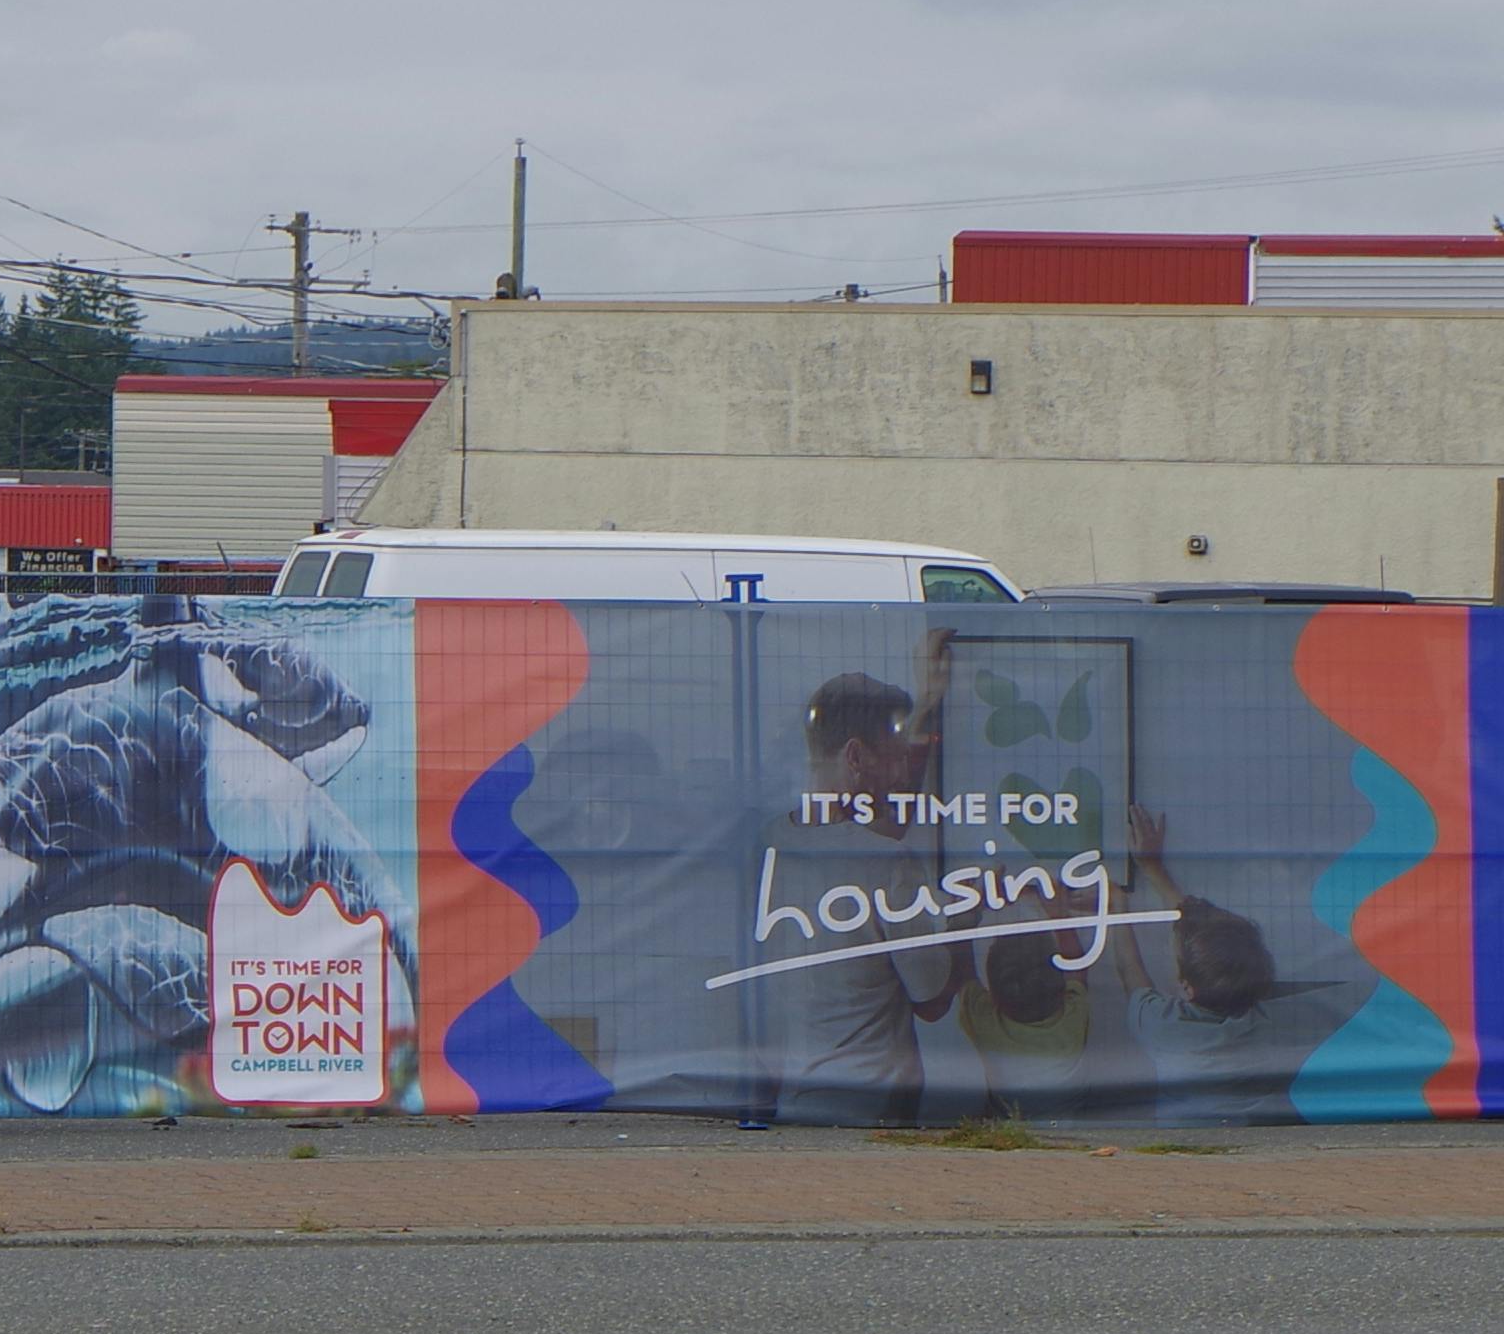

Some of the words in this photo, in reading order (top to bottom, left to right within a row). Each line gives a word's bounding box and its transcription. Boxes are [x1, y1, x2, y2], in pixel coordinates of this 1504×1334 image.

[21, 551, 42, 562] We
[46, 551, 81, 562] Offer
[801, 793, 875, 825] IT'S
[888, 793, 987, 825] TIME
[1000, 793, 1079, 825] FOR
[754, 840, 1110, 971] housing
[231, 960, 266, 976] IT'S
[273, 960, 321, 976] TIME
[327, 959, 363, 975] FOR
[232, 982, 364, 1017] DOWN
[232, 1021, 364, 1055] TOWN
[231, 1059, 315, 1073] CAMPBELL
[318, 1059, 364, 1073] RIVER
